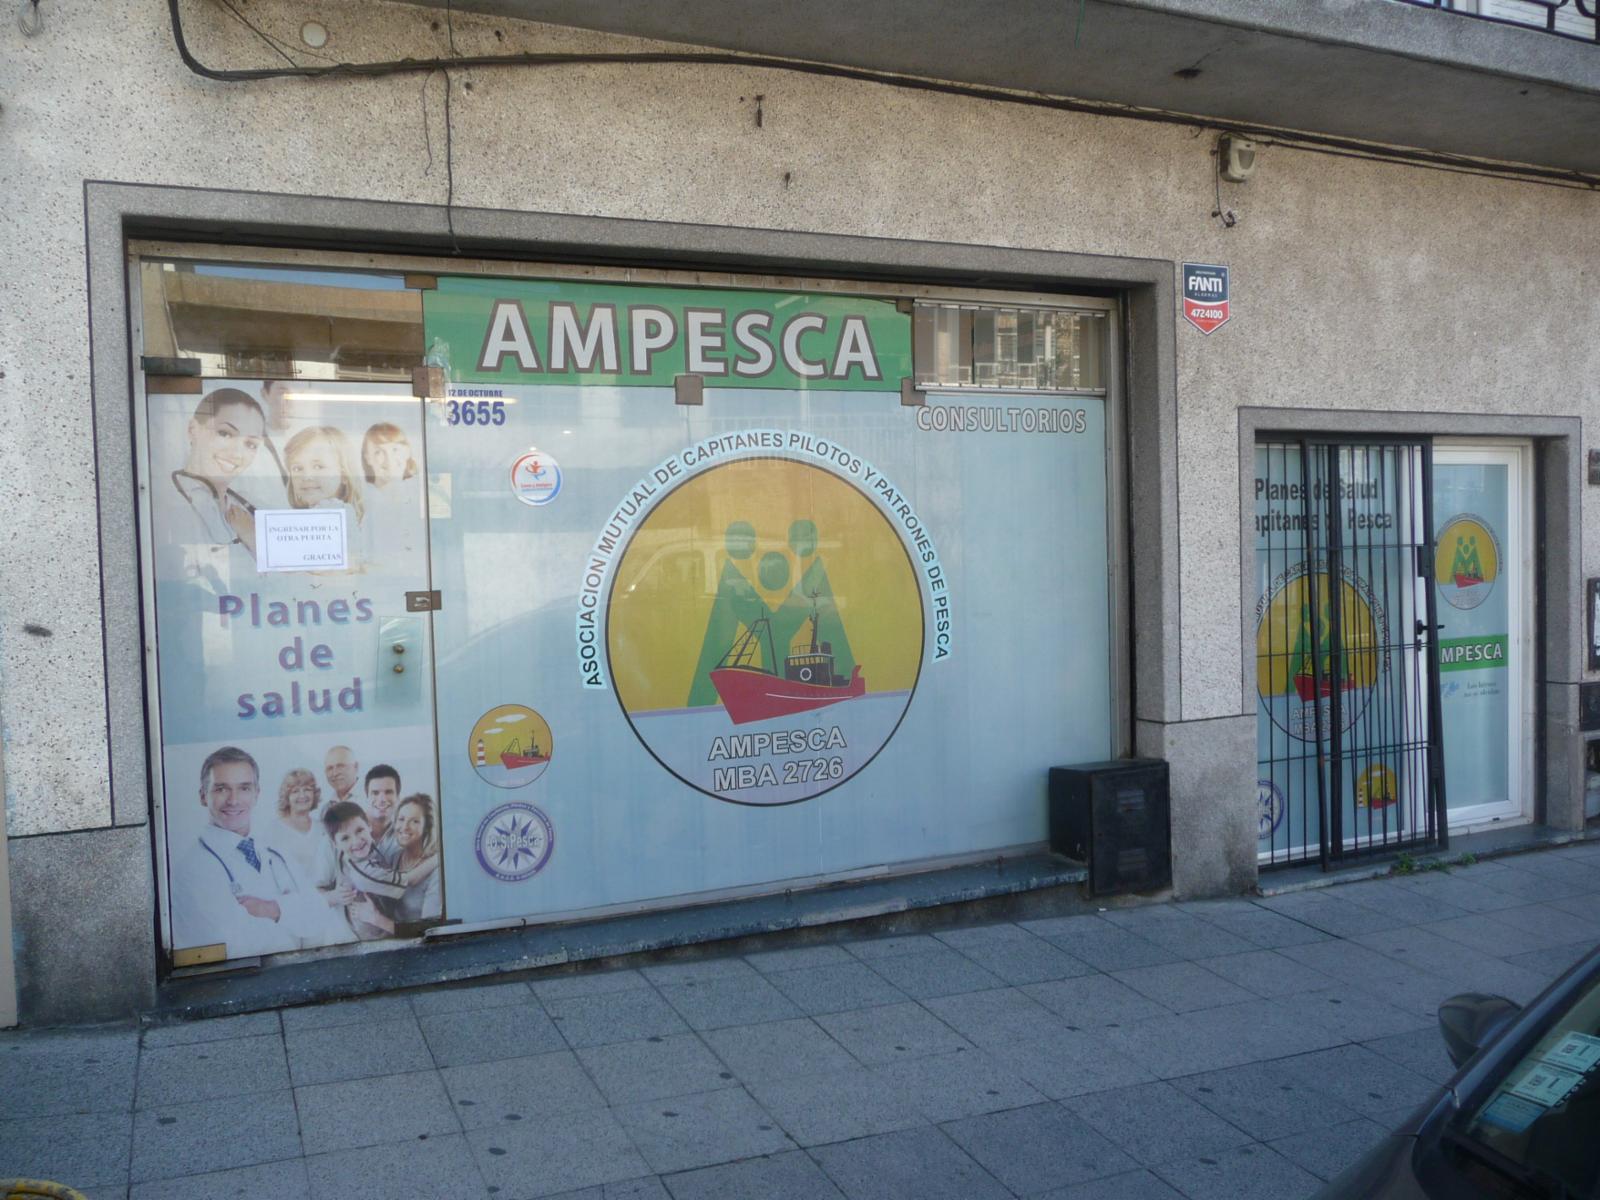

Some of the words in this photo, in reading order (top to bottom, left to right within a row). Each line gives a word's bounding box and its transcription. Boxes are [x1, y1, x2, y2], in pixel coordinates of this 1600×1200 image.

[1188, 275, 1223, 293] FANTI
[1191, 308, 1223, 319] 4724100
[476, 299, 883, 382] AMPESCA
[457, 389, 468, 397] DE
[446, 399, 506, 426] 3655
[916, 405, 1087, 434] CONSULTORIOS
[683, 432, 783, 467] CAPITANES
[789, 433, 862, 474] PILOTOS
[654, 459, 682, 485] DE
[864, 467, 877, 481] Y
[598, 483, 657, 554] MUTUAL
[874, 478, 935, 563] PATRONES
[303, 553, 342, 561] GRACIAS
[927, 565, 945, 592] DE
[218, 592, 375, 628] Planes
[579, 558, 607, 686] ASOCIACION
[934, 596, 950, 659] PESCA
[278, 636, 336, 671] de
[1440, 642, 1504, 664] MPESCA
[237, 676, 364, 721] salud
[708, 726, 848, 761] AMPESCA
[713, 763, 779, 792] MBA
[783, 756, 844, 784] 2726
